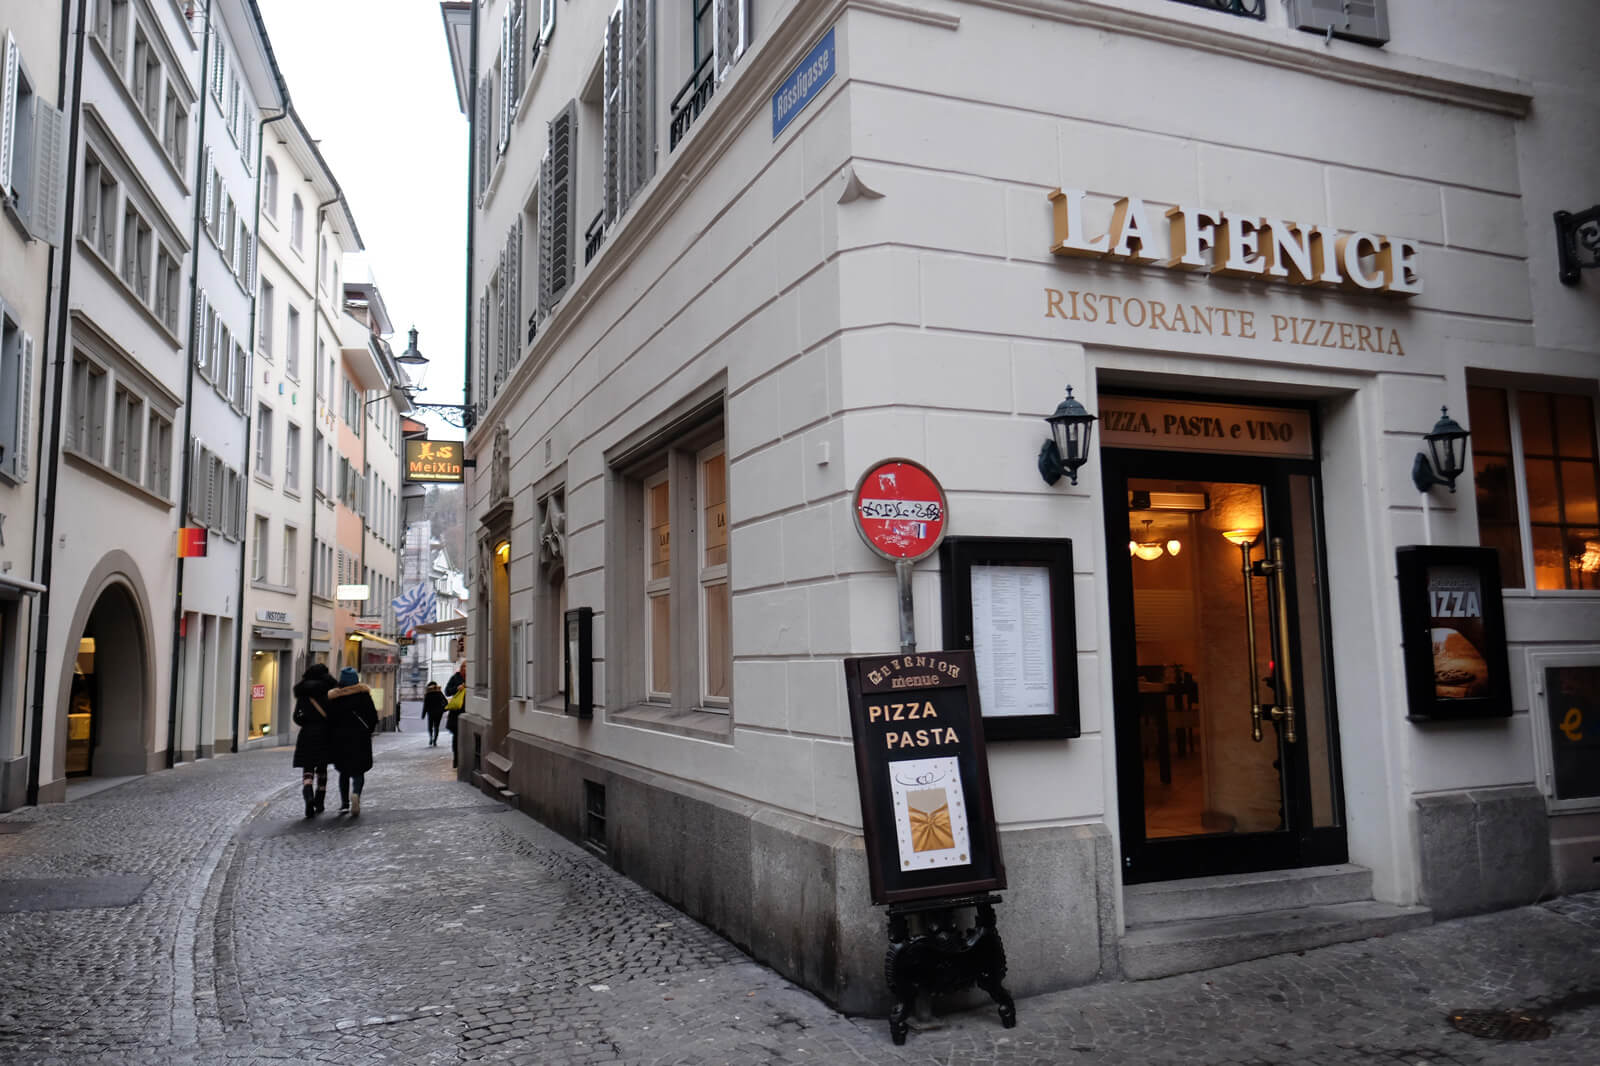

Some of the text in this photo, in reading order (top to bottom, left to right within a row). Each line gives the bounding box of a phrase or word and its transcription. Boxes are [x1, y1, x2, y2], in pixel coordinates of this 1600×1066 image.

[777, 48, 829, 121] Rössligasse
[1048, 187, 1424, 297] LA FENICE
[1044, 287, 1405, 356] RISTORANTE PIZZERIA
[1101, 411, 1294, 442] IZZA, PASTA e VINO
[409, 461, 461, 473] MeiXin
[253, 687, 264, 697] SALE
[891, 674, 940, 688] menue
[868, 701, 938, 723] PIZZA
[885, 727, 960, 749] PASTA
